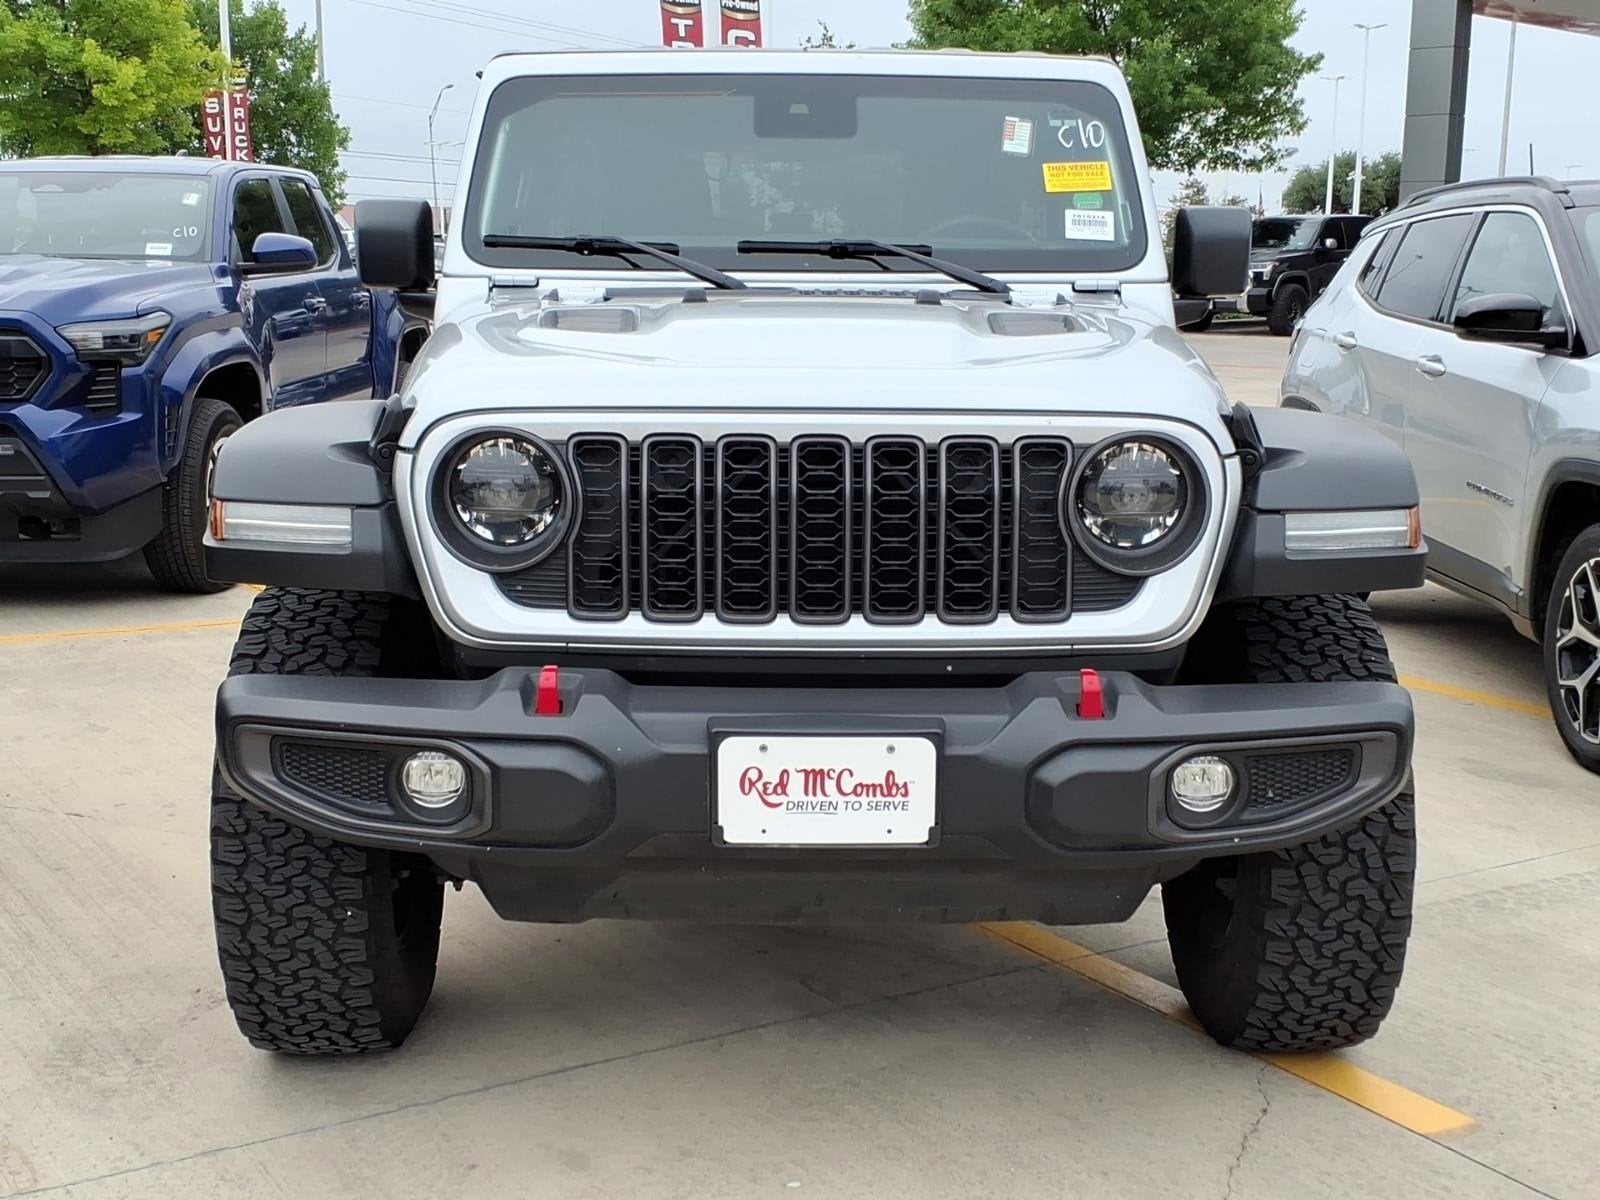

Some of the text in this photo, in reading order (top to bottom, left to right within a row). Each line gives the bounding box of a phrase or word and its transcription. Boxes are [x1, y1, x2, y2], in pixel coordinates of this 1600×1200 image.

[205, 97, 222, 160] SUV
[1068, 163, 1106, 171] VEHICLE
[739, 766, 910, 809] Red McCombs
[785, 800, 910, 812] DRIVEN TO SERVE
